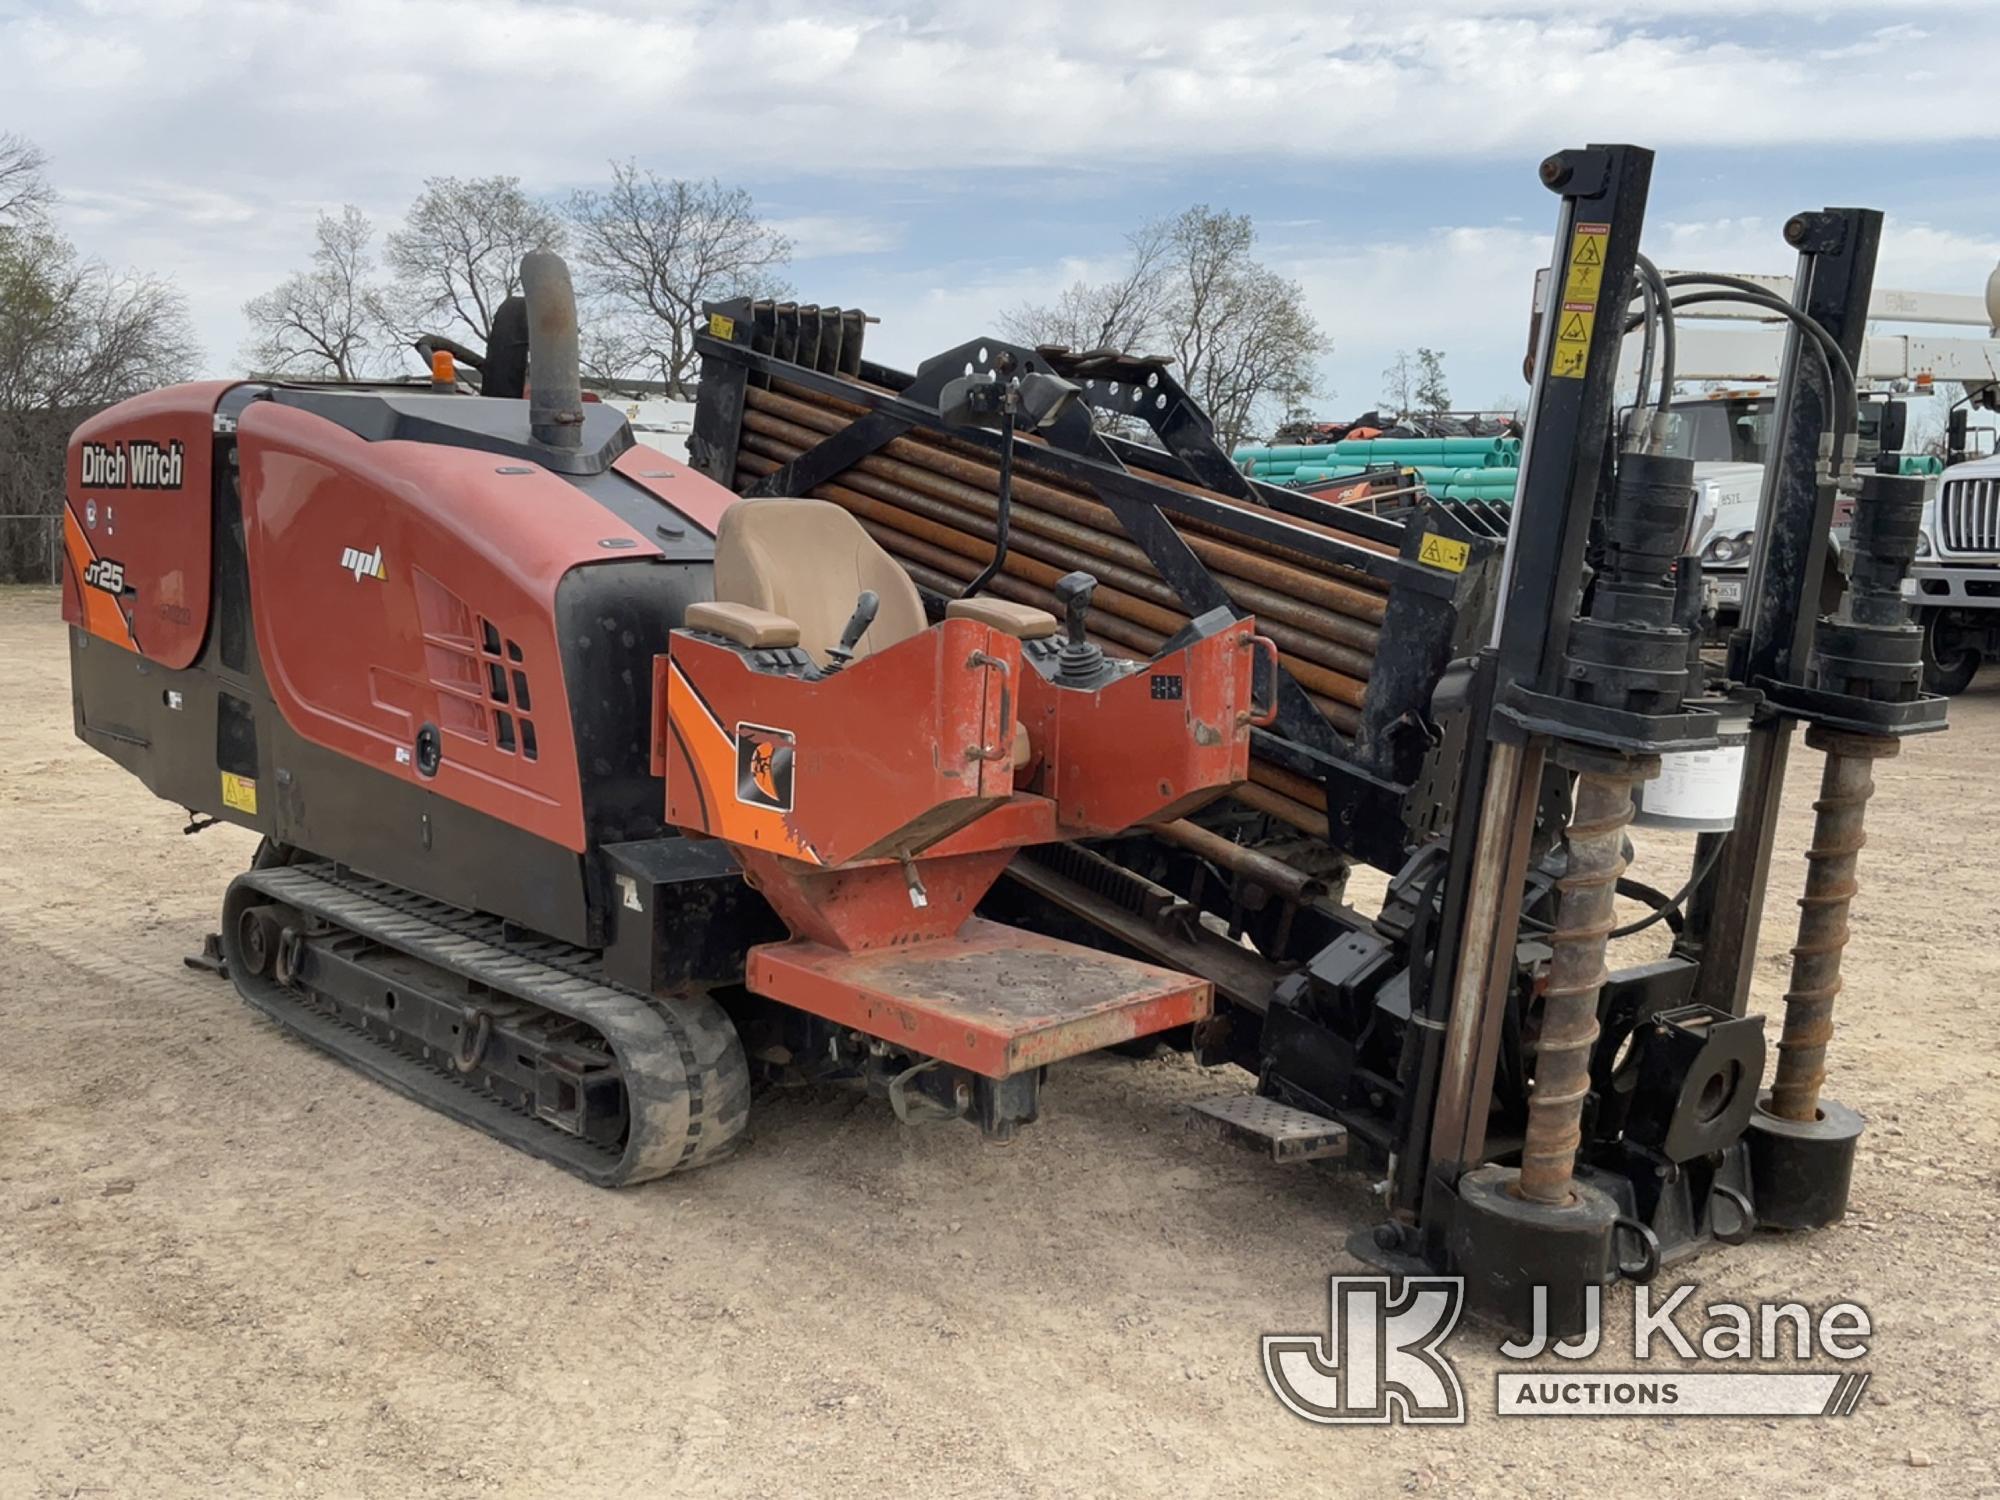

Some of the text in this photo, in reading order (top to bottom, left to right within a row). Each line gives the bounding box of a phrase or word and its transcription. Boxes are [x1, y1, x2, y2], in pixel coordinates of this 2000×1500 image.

[81, 443, 183, 486] Ditch Witch
[84, 560, 125, 594] JT25
